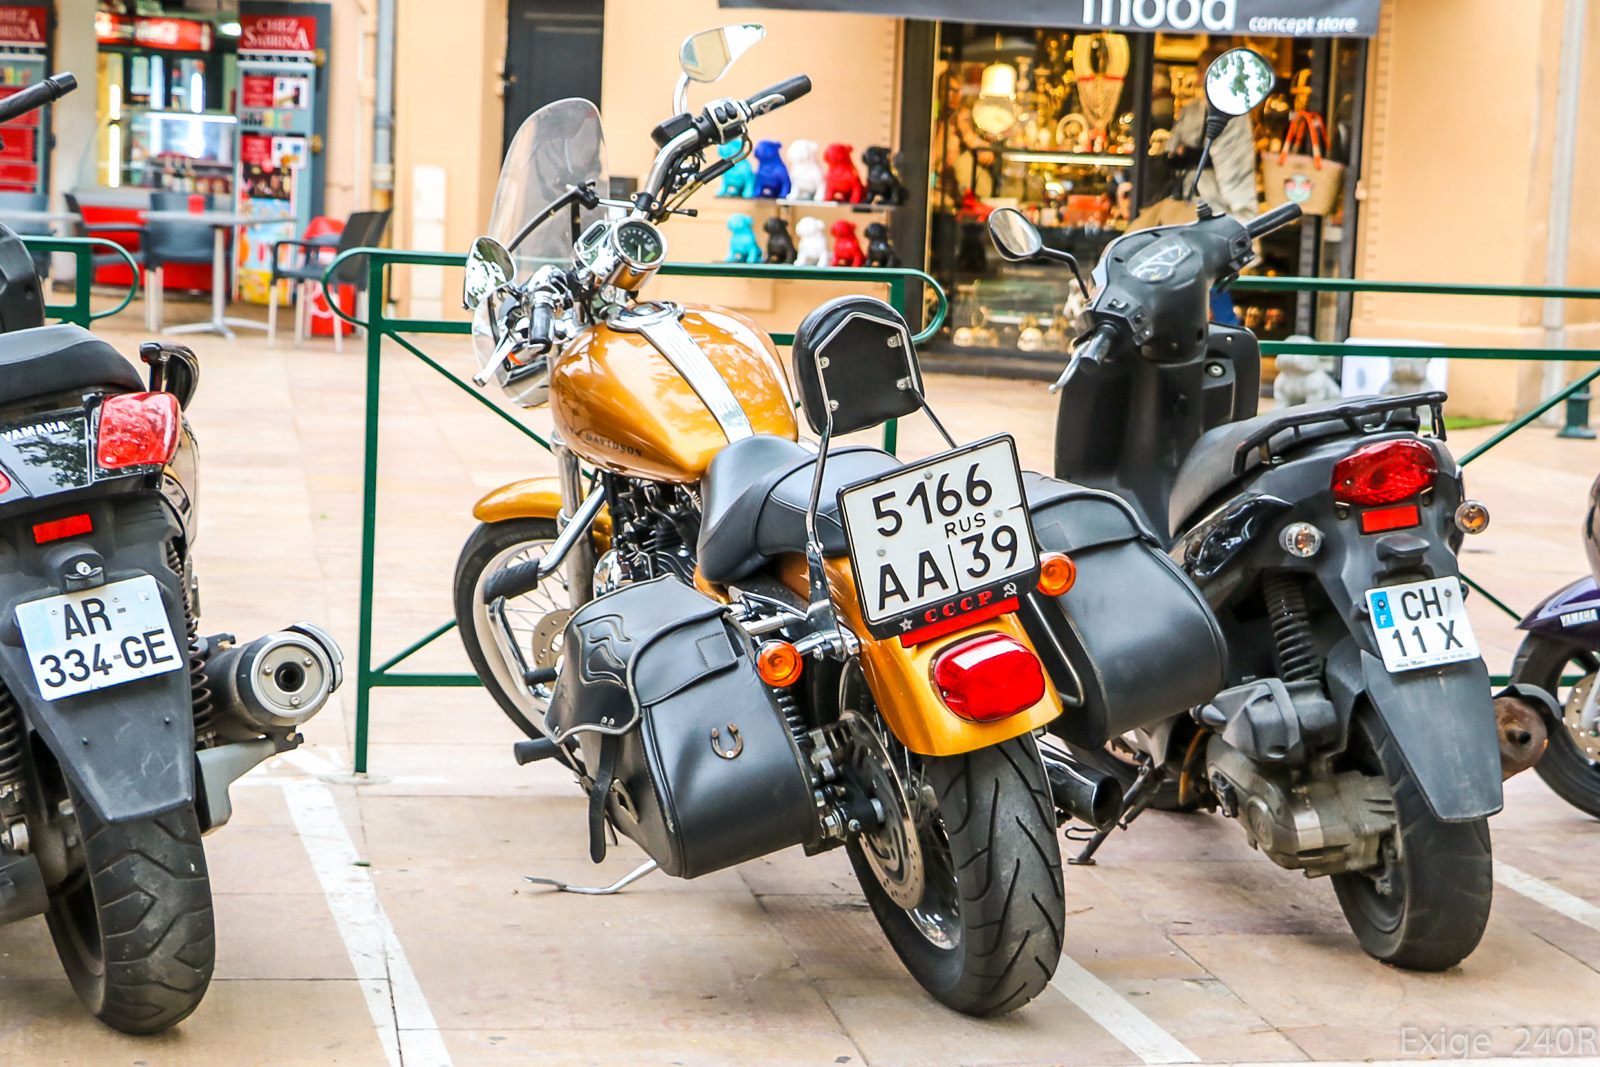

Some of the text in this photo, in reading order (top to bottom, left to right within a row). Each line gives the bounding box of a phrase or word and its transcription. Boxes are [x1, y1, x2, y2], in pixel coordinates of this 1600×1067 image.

[1248, 16, 1359, 37] concept store
[0, 419, 71, 443] YAMAHA
[585, 433, 643, 457] DAVIDSON
[872, 462, 993, 538] 5166
[944, 512, 986, 538] RUS
[878, 525, 1018, 612] AA 39
[1400, 586, 1444, 622] CH
[1379, 614, 1388, 626] F
[1560, 609, 1599, 627] YAMAHA
[1392, 619, 1464, 658] 11 X
[40, 628, 174, 688] 334-GE
